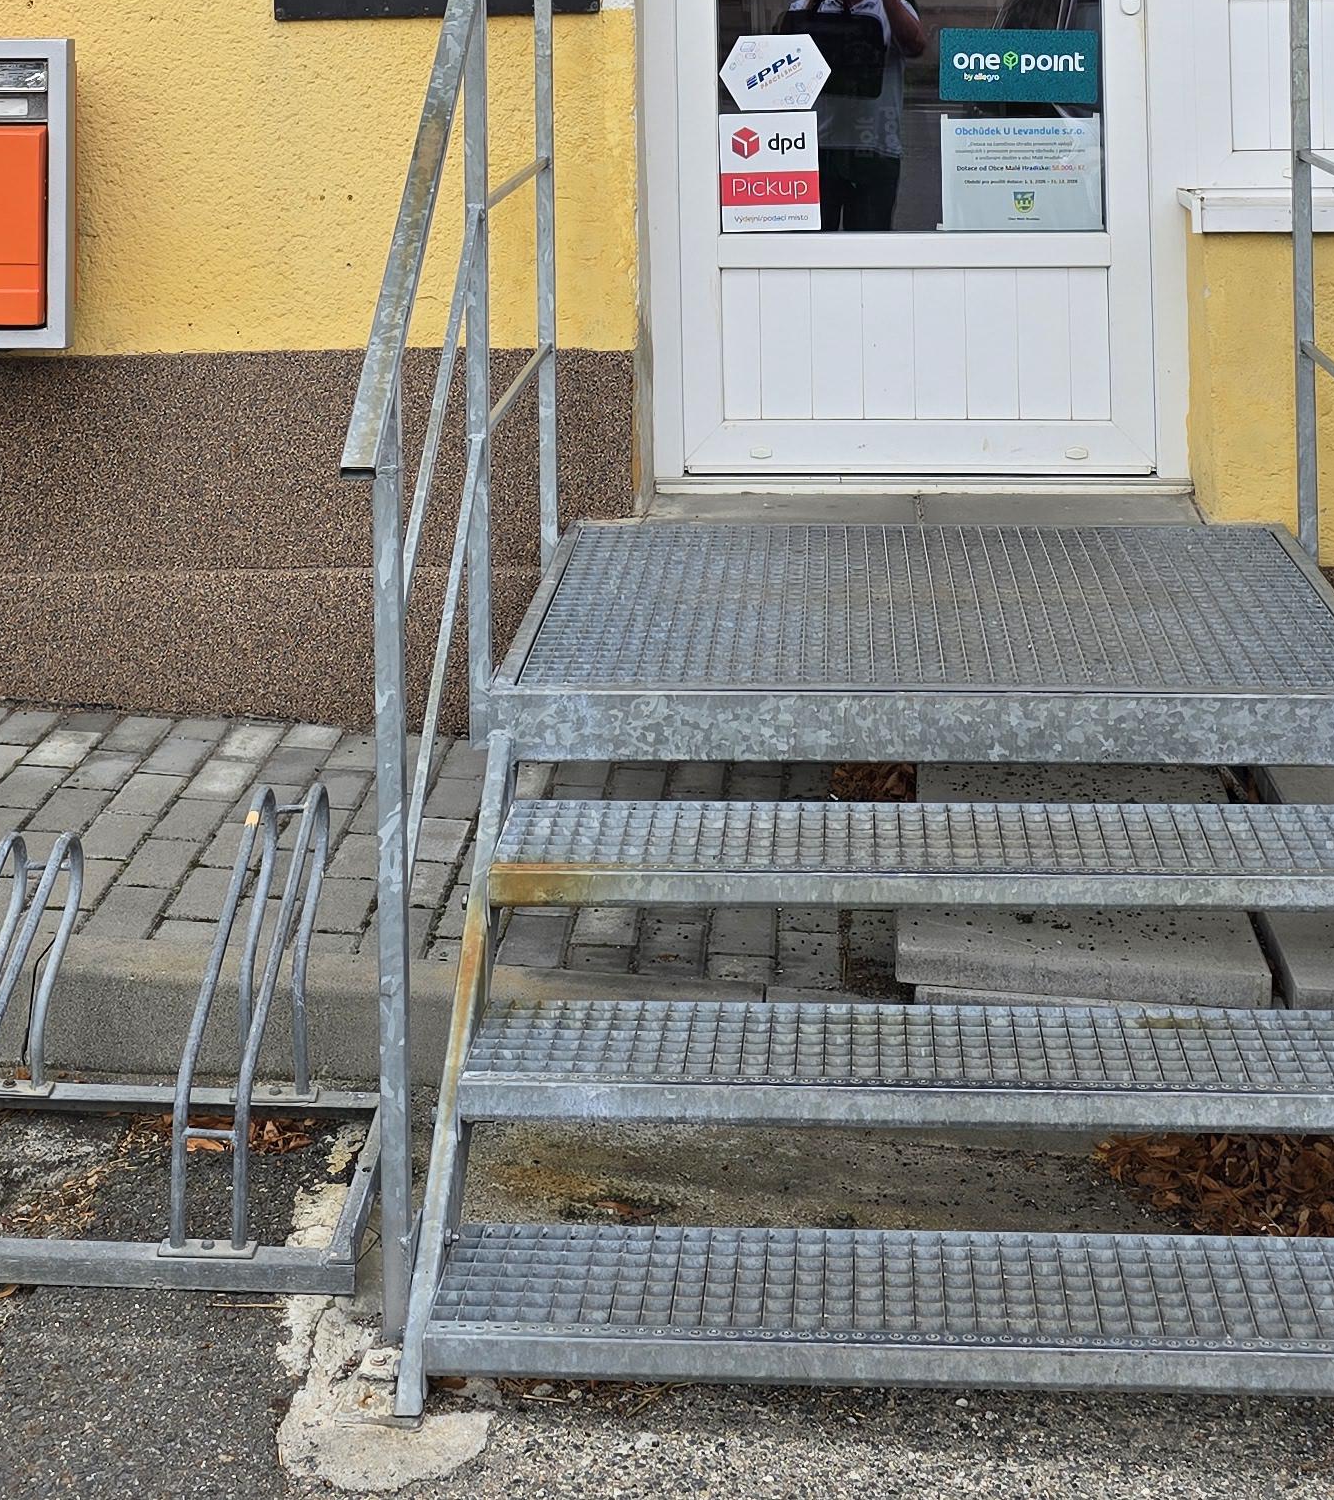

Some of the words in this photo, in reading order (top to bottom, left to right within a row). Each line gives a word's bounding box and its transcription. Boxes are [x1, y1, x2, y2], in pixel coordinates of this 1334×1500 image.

[953, 52, 1001, 70] one
[1020, 52, 1085, 74] point
[963, 72, 973, 82] by
[973, 73, 1000, 82] allegro
[954, 127, 1001, 136] Obchůdek
[1003, 127, 1011, 135] U
[1013, 126, 1060, 136] Levandule
[767, 131, 806, 155] dpd
[732, 177, 808, 199] Pickup
